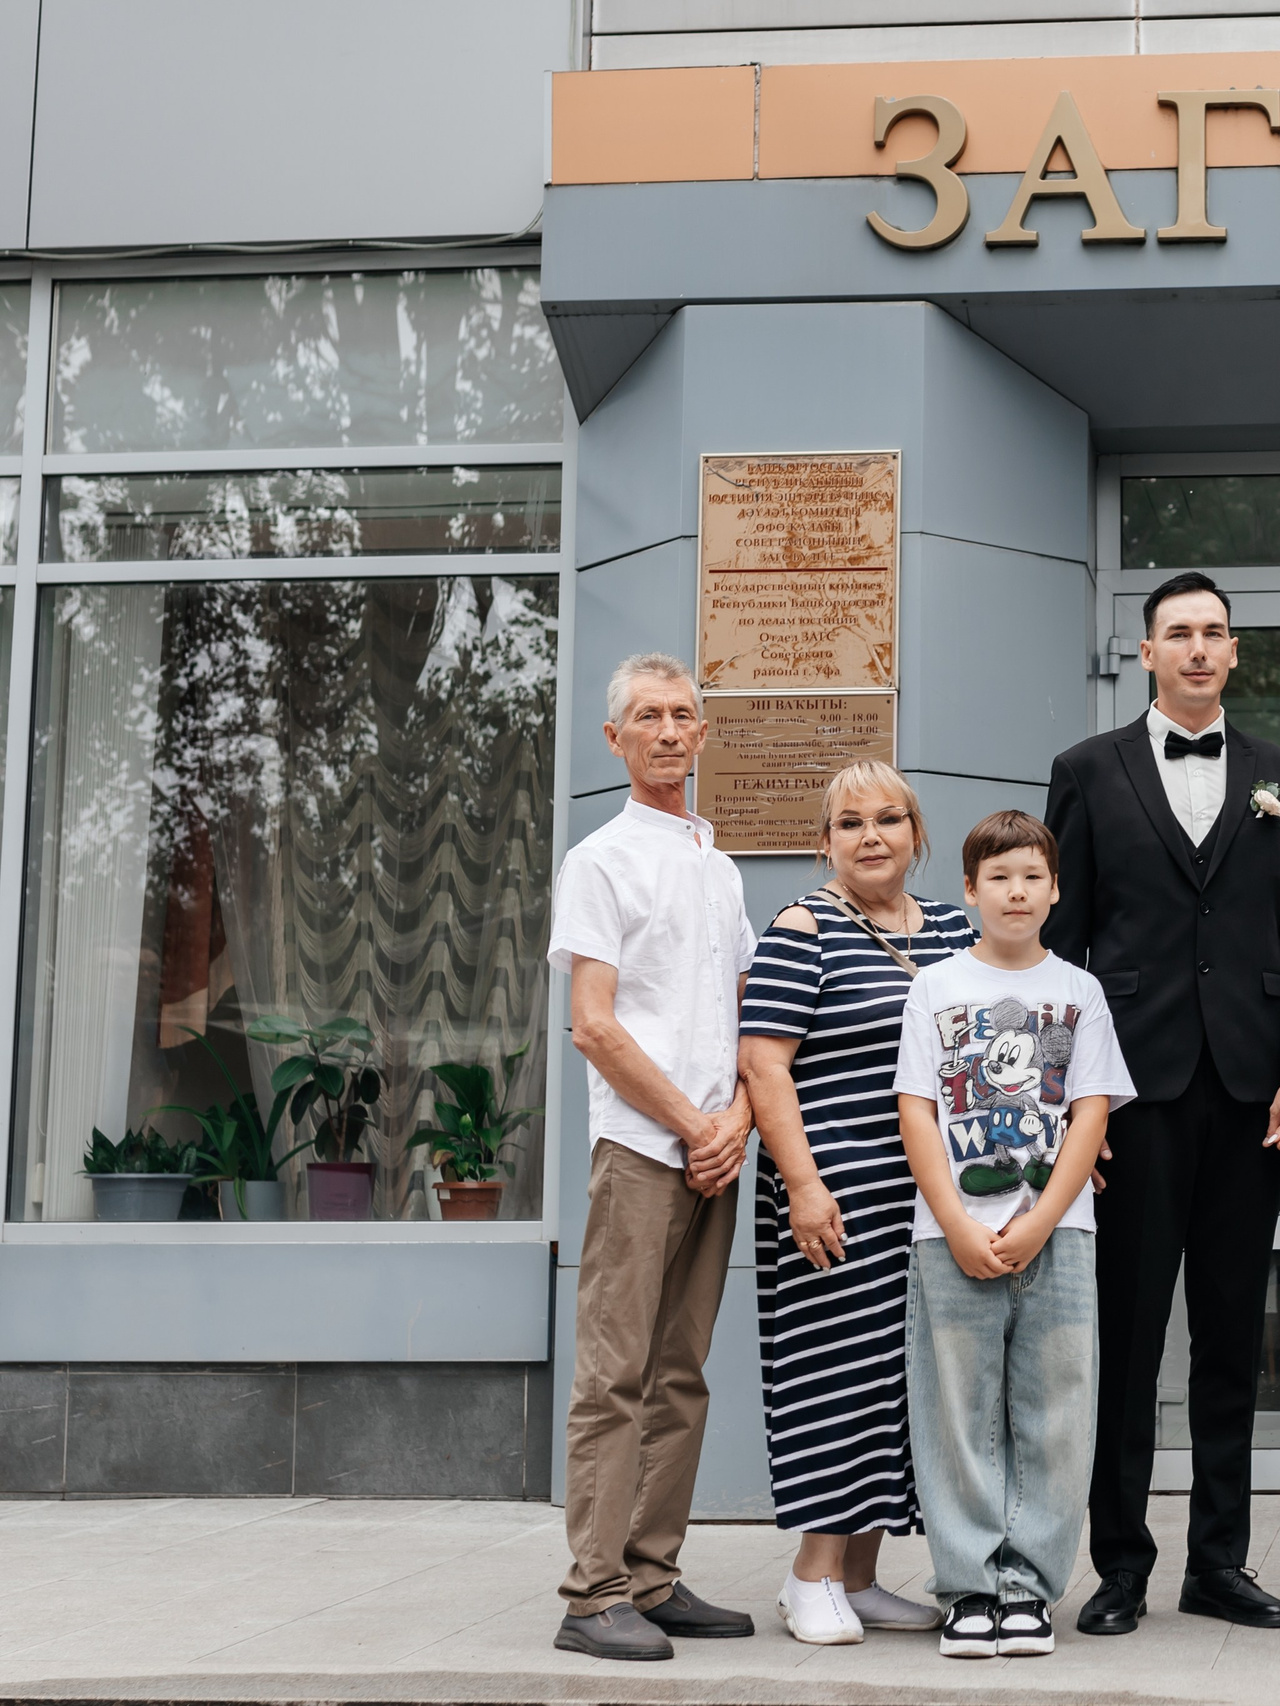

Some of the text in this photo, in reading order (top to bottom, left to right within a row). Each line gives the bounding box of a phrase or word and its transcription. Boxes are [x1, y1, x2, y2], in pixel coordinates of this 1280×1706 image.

[713, 582, 826, 594] Государственный
[712, 598, 885, 611] Республики Башкортостан
[758, 618, 796, 627] делам
[759, 631, 836, 643] Отдел ЗАГС
[761, 649, 833, 659] Советского
[753, 667, 799, 679] района
[816, 664, 841, 678] Уфа
[746, 700, 771, 711] ЭШ
[820, 713, 841, 723] 9.00
[852, 713, 879, 722] 18.00
[733, 778, 789, 790] РЕЖИМ
[715, 794, 758, 804] Вторник
[766, 794, 805, 805] суббота
[715, 806, 760, 816] Перерыв
